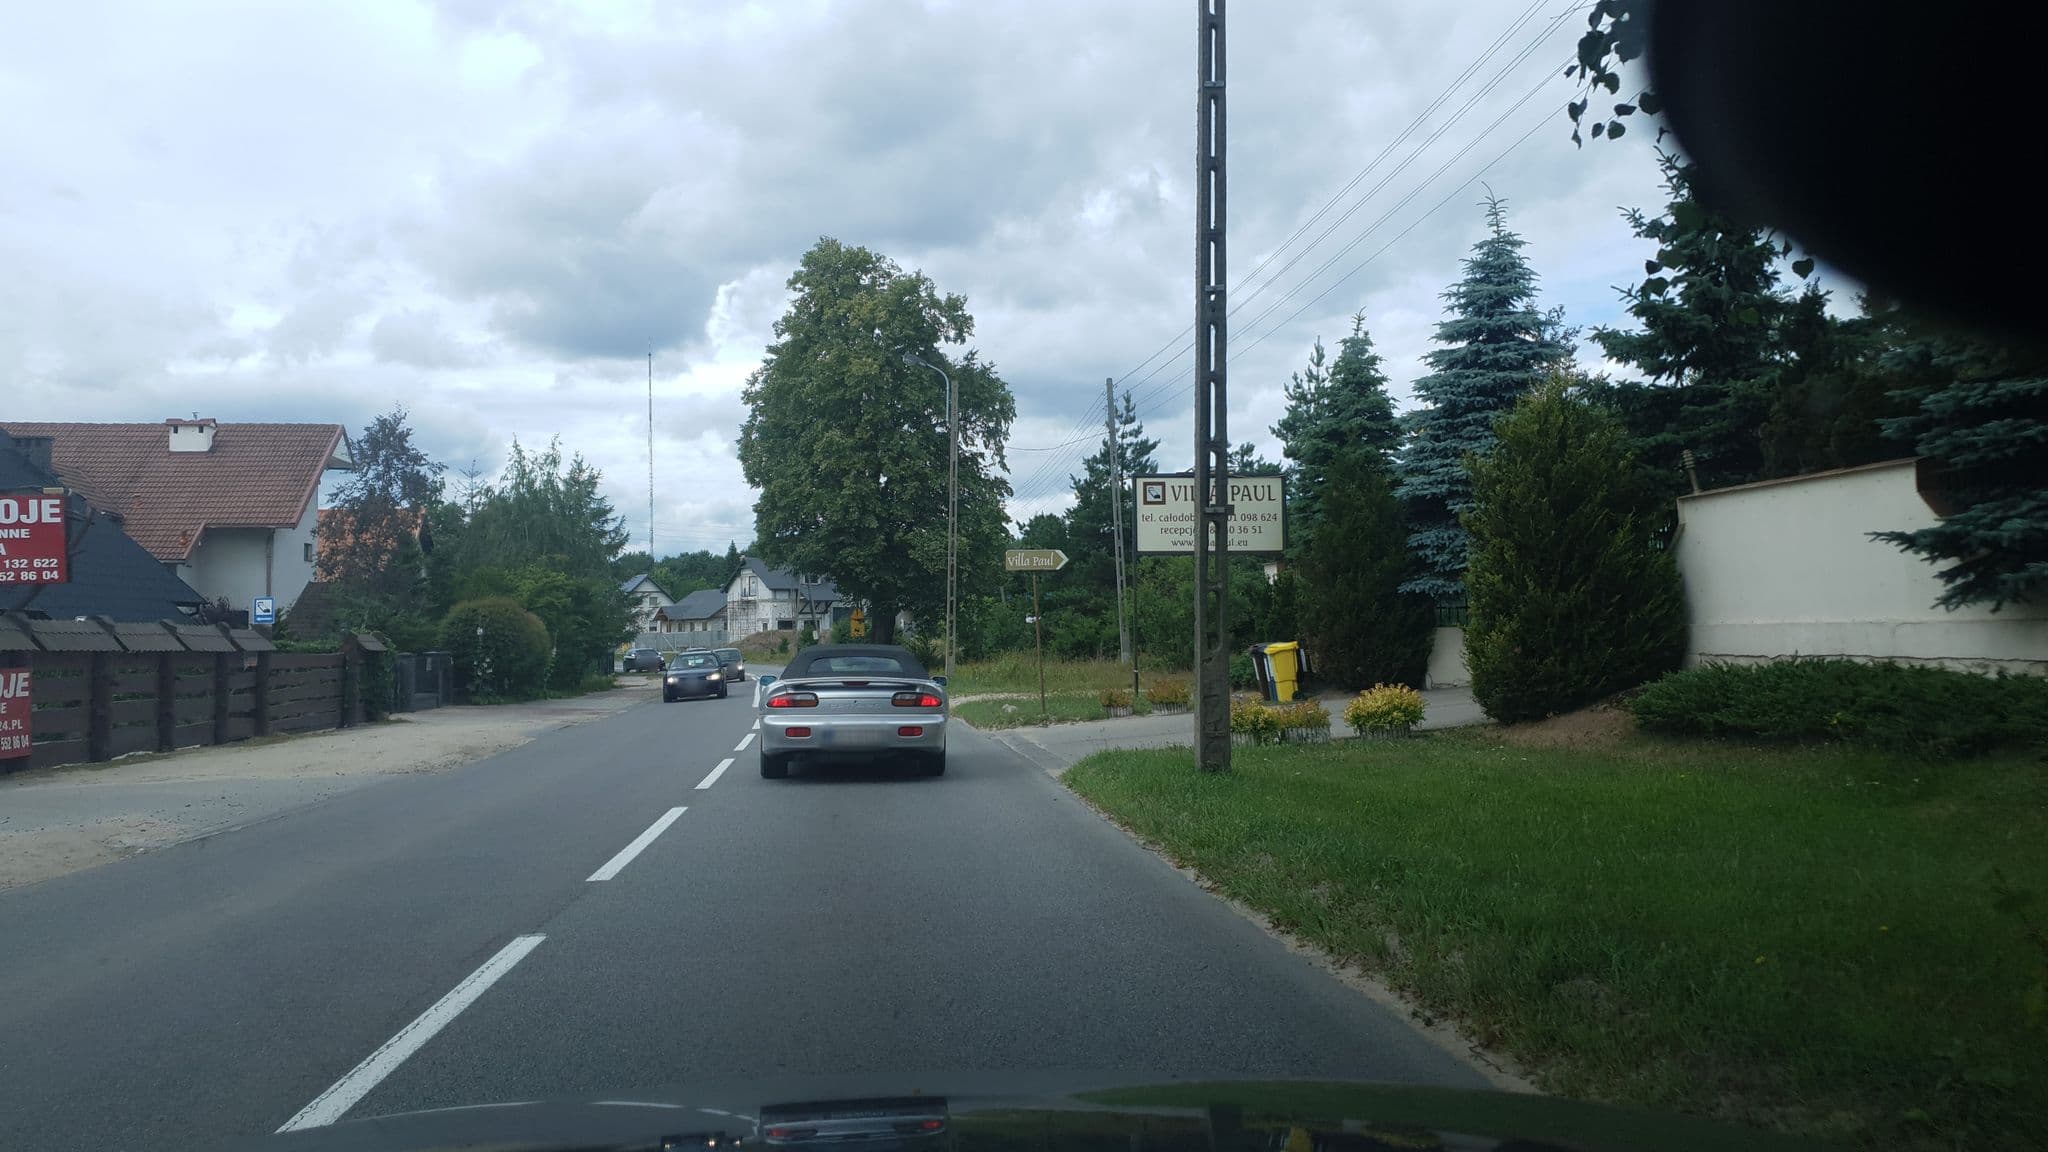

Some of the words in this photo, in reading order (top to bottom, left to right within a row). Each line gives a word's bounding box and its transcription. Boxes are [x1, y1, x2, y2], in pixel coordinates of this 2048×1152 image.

[1171, 485, 1216, 502] VIA
[1231, 485, 1277, 502] PAUL
[1142, 512, 1156, 523] tel.
[1240, 513, 1258, 523] 098
[1261, 513, 1277, 523] 624
[1160, 526, 1195, 537] recepcj
[1237, 526, 1249, 535] 36
[1252, 526, 1263, 535] 51
[4, 558, 29, 569] 132
[33, 558, 59, 568] 622
[1008, 551, 1030, 567] Villa
[1032, 551, 1054, 567] Paul
[20, 570, 37, 581] 86
[42, 570, 59, 580] 04
